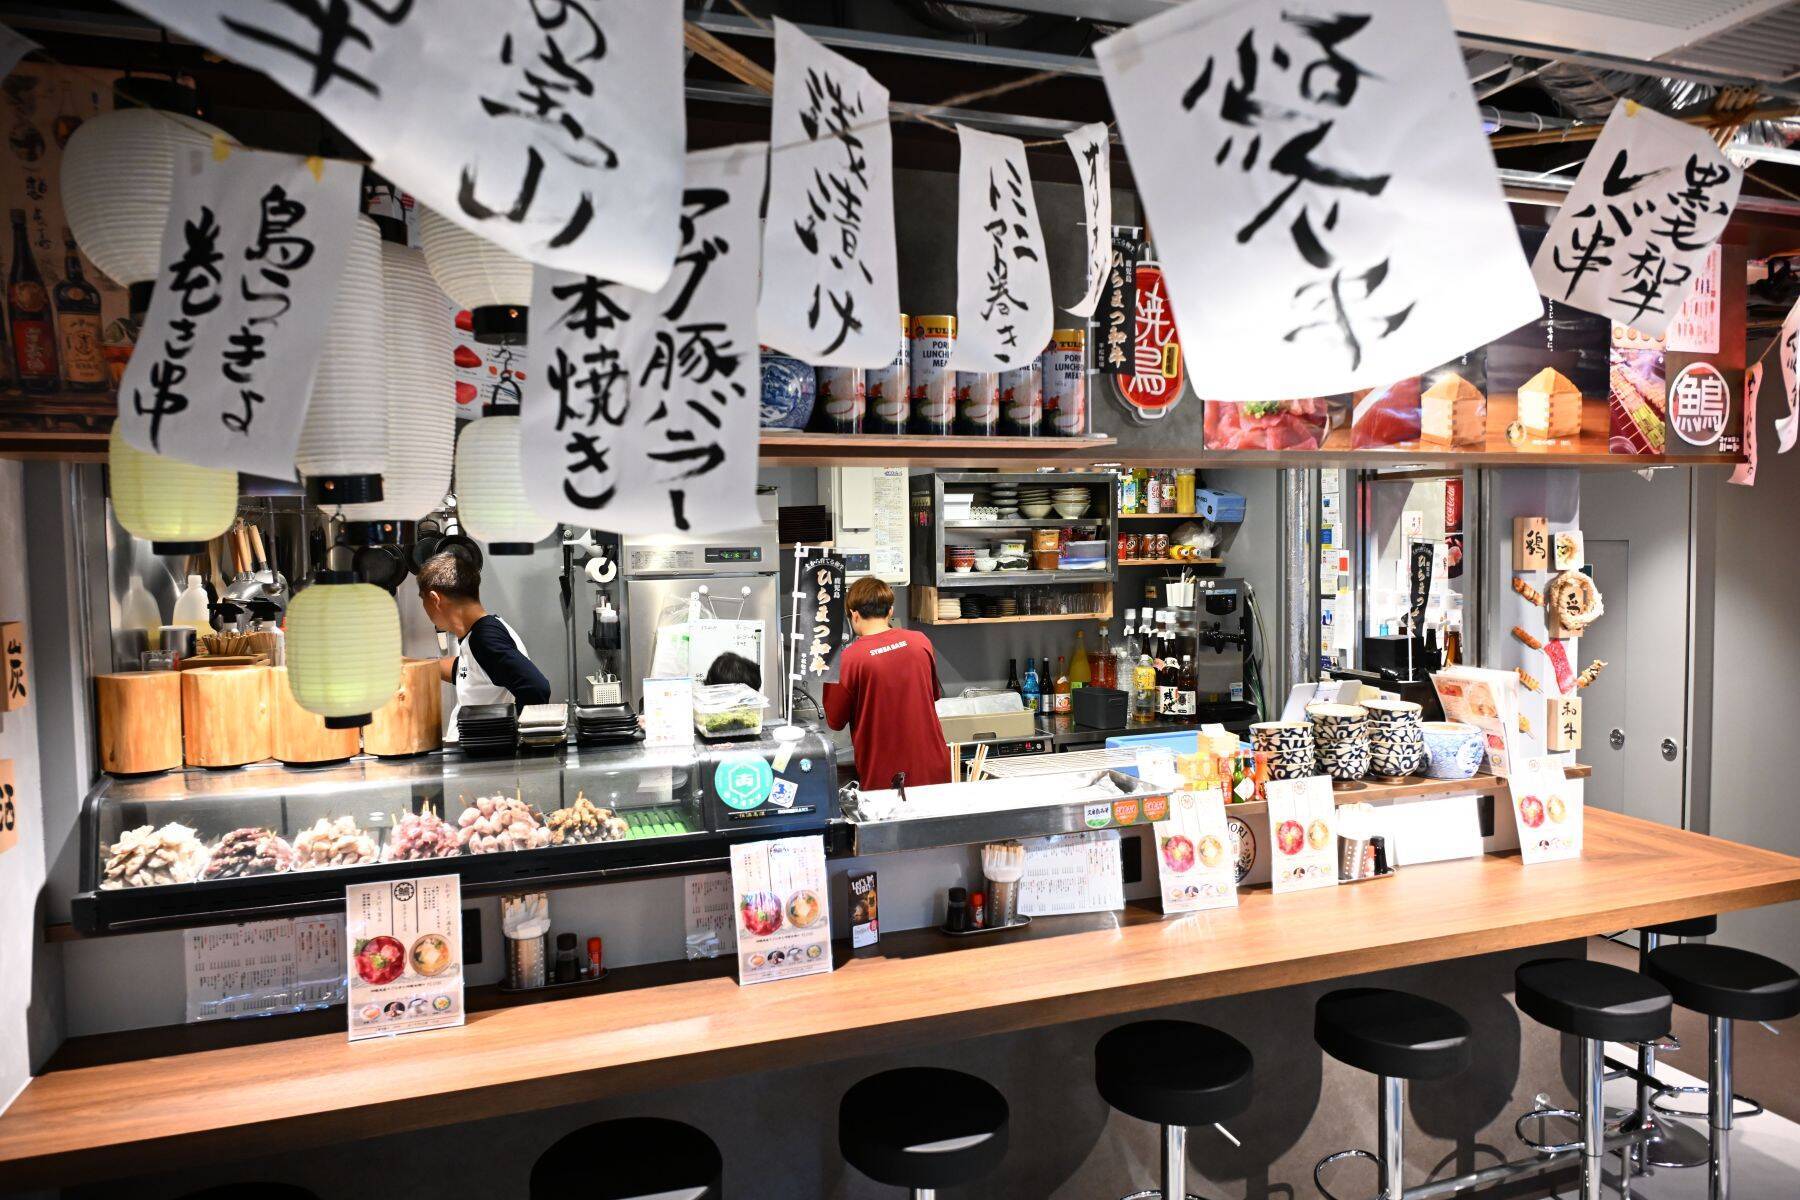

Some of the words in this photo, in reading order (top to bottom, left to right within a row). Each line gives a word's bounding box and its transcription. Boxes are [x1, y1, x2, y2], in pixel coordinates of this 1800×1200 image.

[1553, 148, 1673, 302] レバ串
[1608, 153, 1732, 326] 黒毛和牛
[134, 204, 225, 454] 巻き串
[932, 341, 951, 350] POR
[1108, 250, 1128, 368] ひらまつ和牛
[1129, 275, 1175, 396] 焼鳥
[809, 568, 832, 677] ひらまつ和牛
[1561, 701, 1578, 741] 和牛
